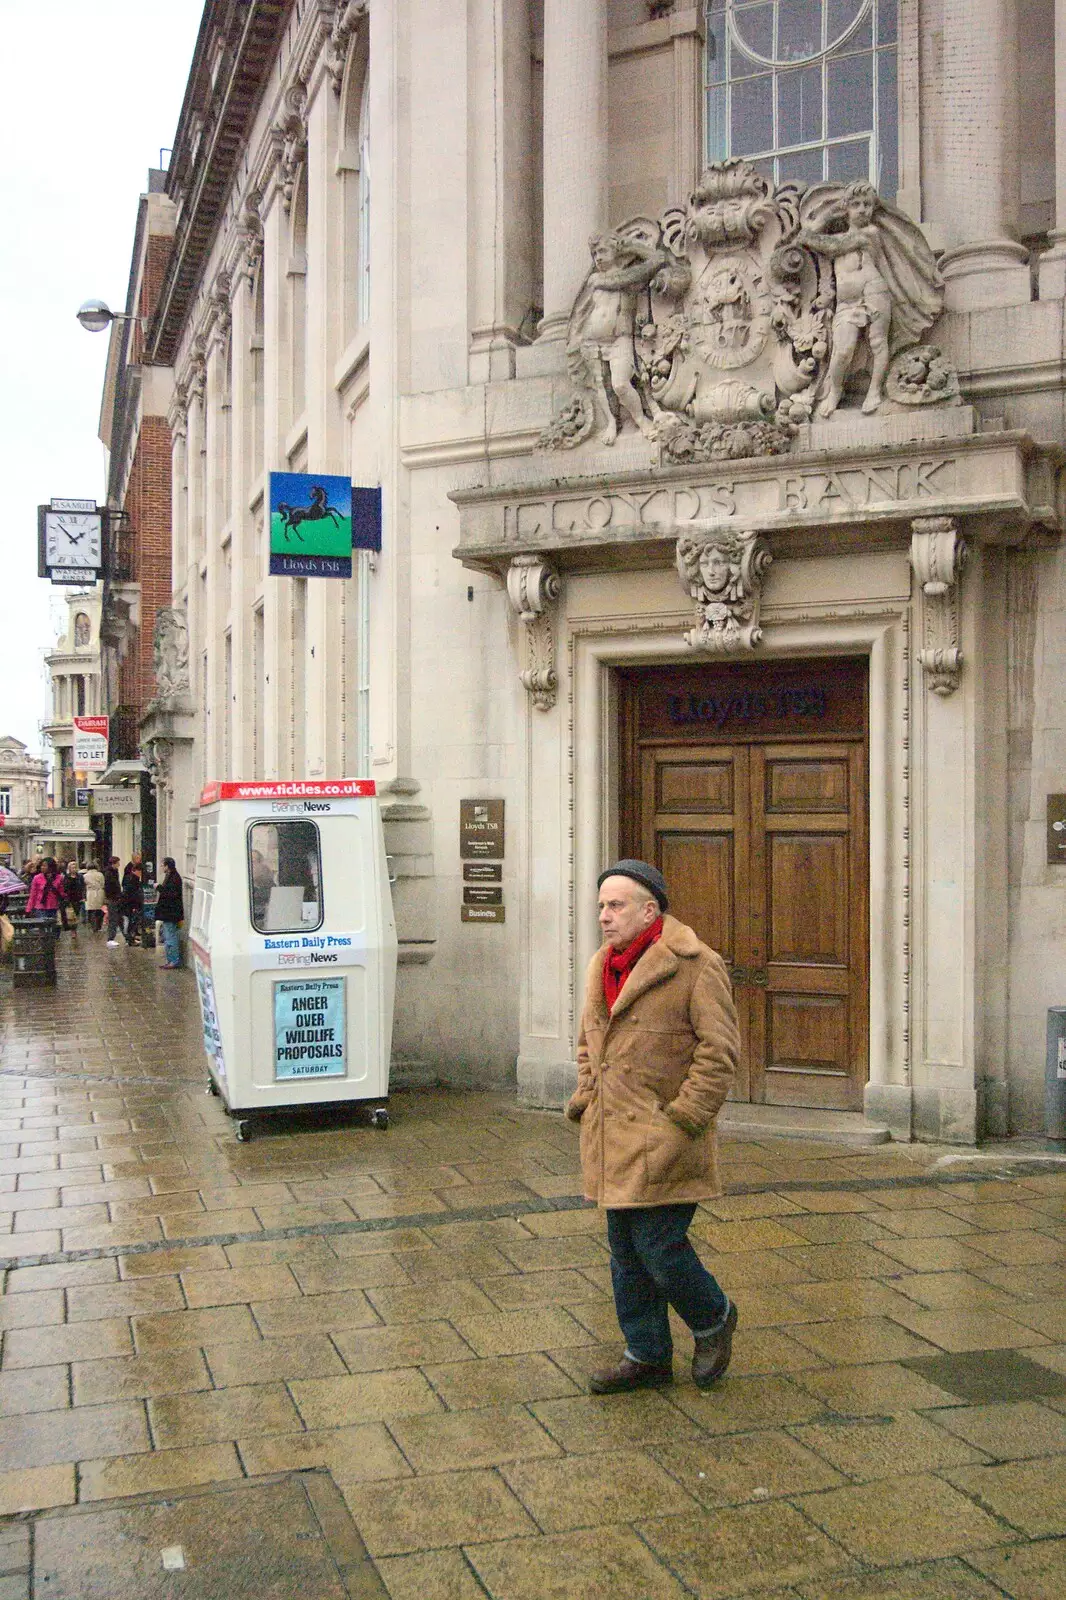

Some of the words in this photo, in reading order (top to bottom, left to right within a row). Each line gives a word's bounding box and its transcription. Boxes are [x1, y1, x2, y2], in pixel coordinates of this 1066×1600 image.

[502, 481, 735, 541] LLOYDS
[776, 460, 955, 511] BANK
[283, 558, 317, 573] Lloyds
[321, 560, 340, 572] TSB
[668, 688, 767, 729] Lloyds
[77, 751, 88, 759] TO
[90, 751, 105, 759] LET
[238, 781, 362, 796] www.tickles.co.uk
[465, 823, 485, 831] Lloyds
[487, 822, 498, 830] TSB
[468, 909, 497, 917] Business
[264, 938, 300, 949] Eastern
[302, 937, 325, 949] Daily
[327, 936, 352, 946] Press
[280, 984, 304, 992] Eastern
[305, 983, 321, 991] Daily
[291, 996, 328, 1012] ANGER
[296, 1013, 325, 1028] OVER
[285, 1028, 335, 1044] WILDLIFE
[277, 1043, 343, 1061] PROPOSALS
[292, 1065, 328, 1075] SATURDAY
